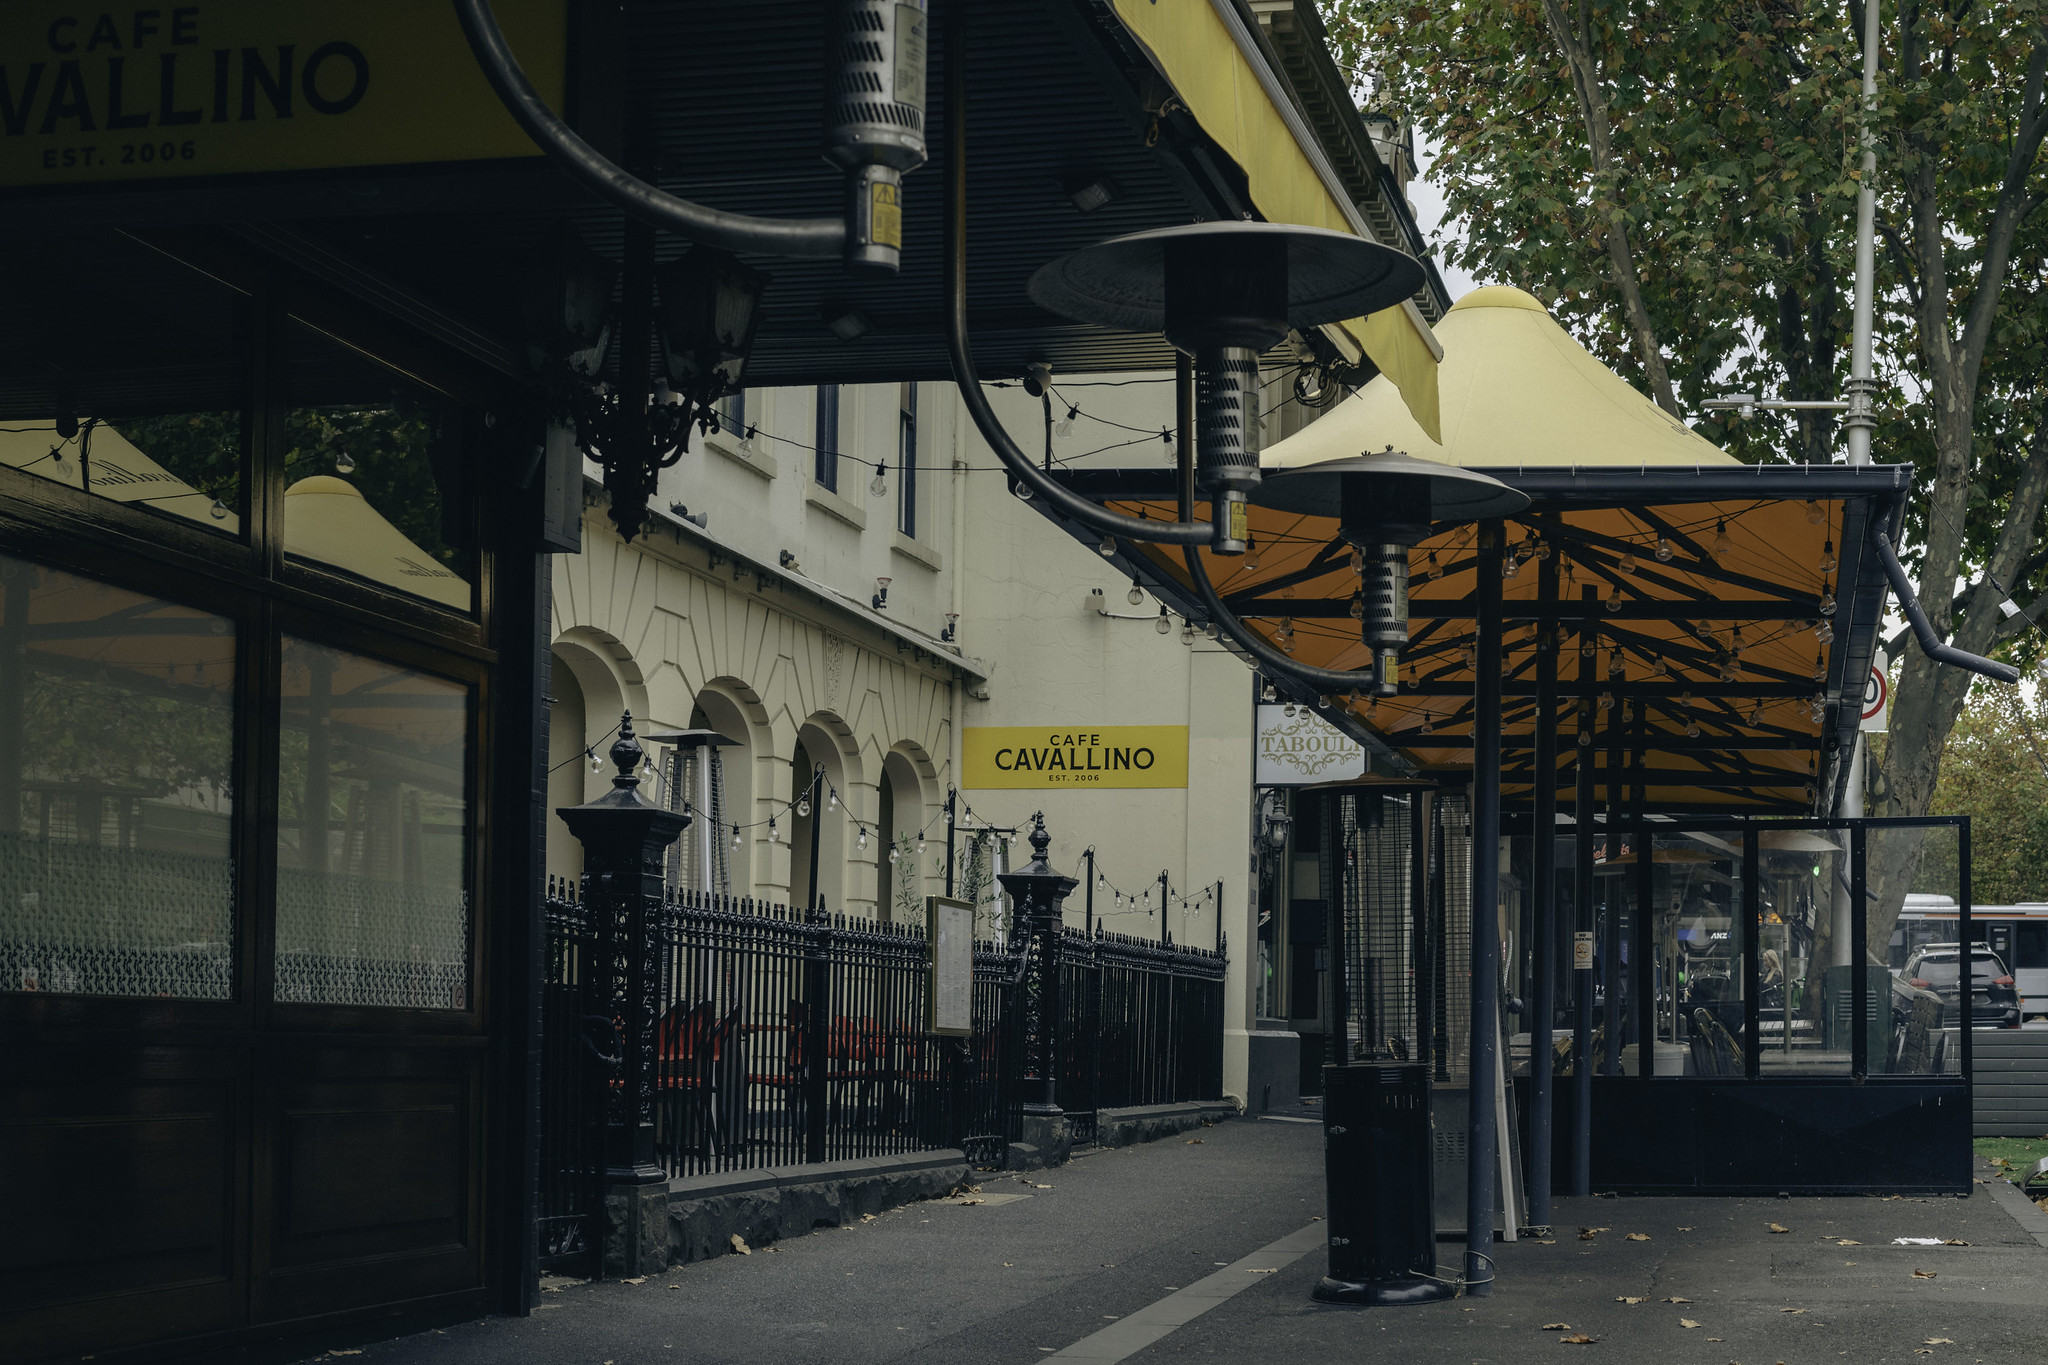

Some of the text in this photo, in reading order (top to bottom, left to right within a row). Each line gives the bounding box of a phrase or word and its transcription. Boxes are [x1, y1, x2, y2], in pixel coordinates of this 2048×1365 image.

[48, 7, 200, 53] CAFE
[42, 141, 195, 168] EST. 2006
[1050, 734, 1100, 746] CAFE
[995, 747, 1155, 771] CAVALLINO
[1710, 932, 1728, 940] ANZ
